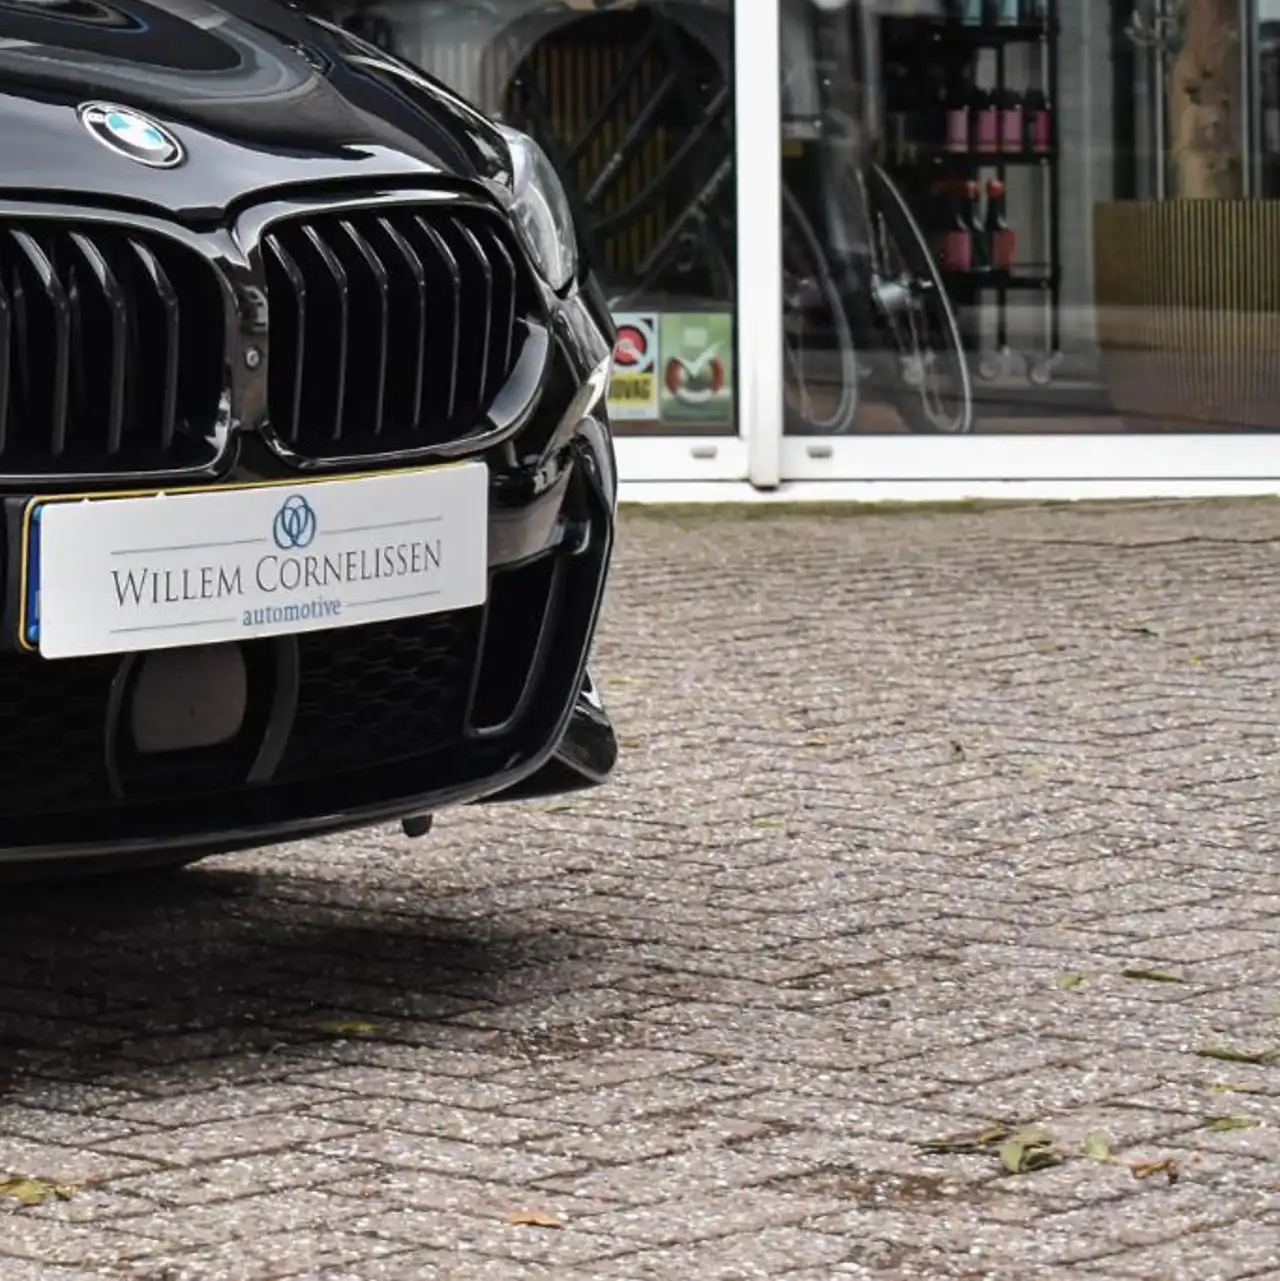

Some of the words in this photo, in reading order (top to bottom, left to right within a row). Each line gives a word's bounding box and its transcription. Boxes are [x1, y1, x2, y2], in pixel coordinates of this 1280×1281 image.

[110, 566, 244, 608] WILLEM
[255, 539, 442, 593] CORNELISSEN
[242, 596, 342, 627] automotive
